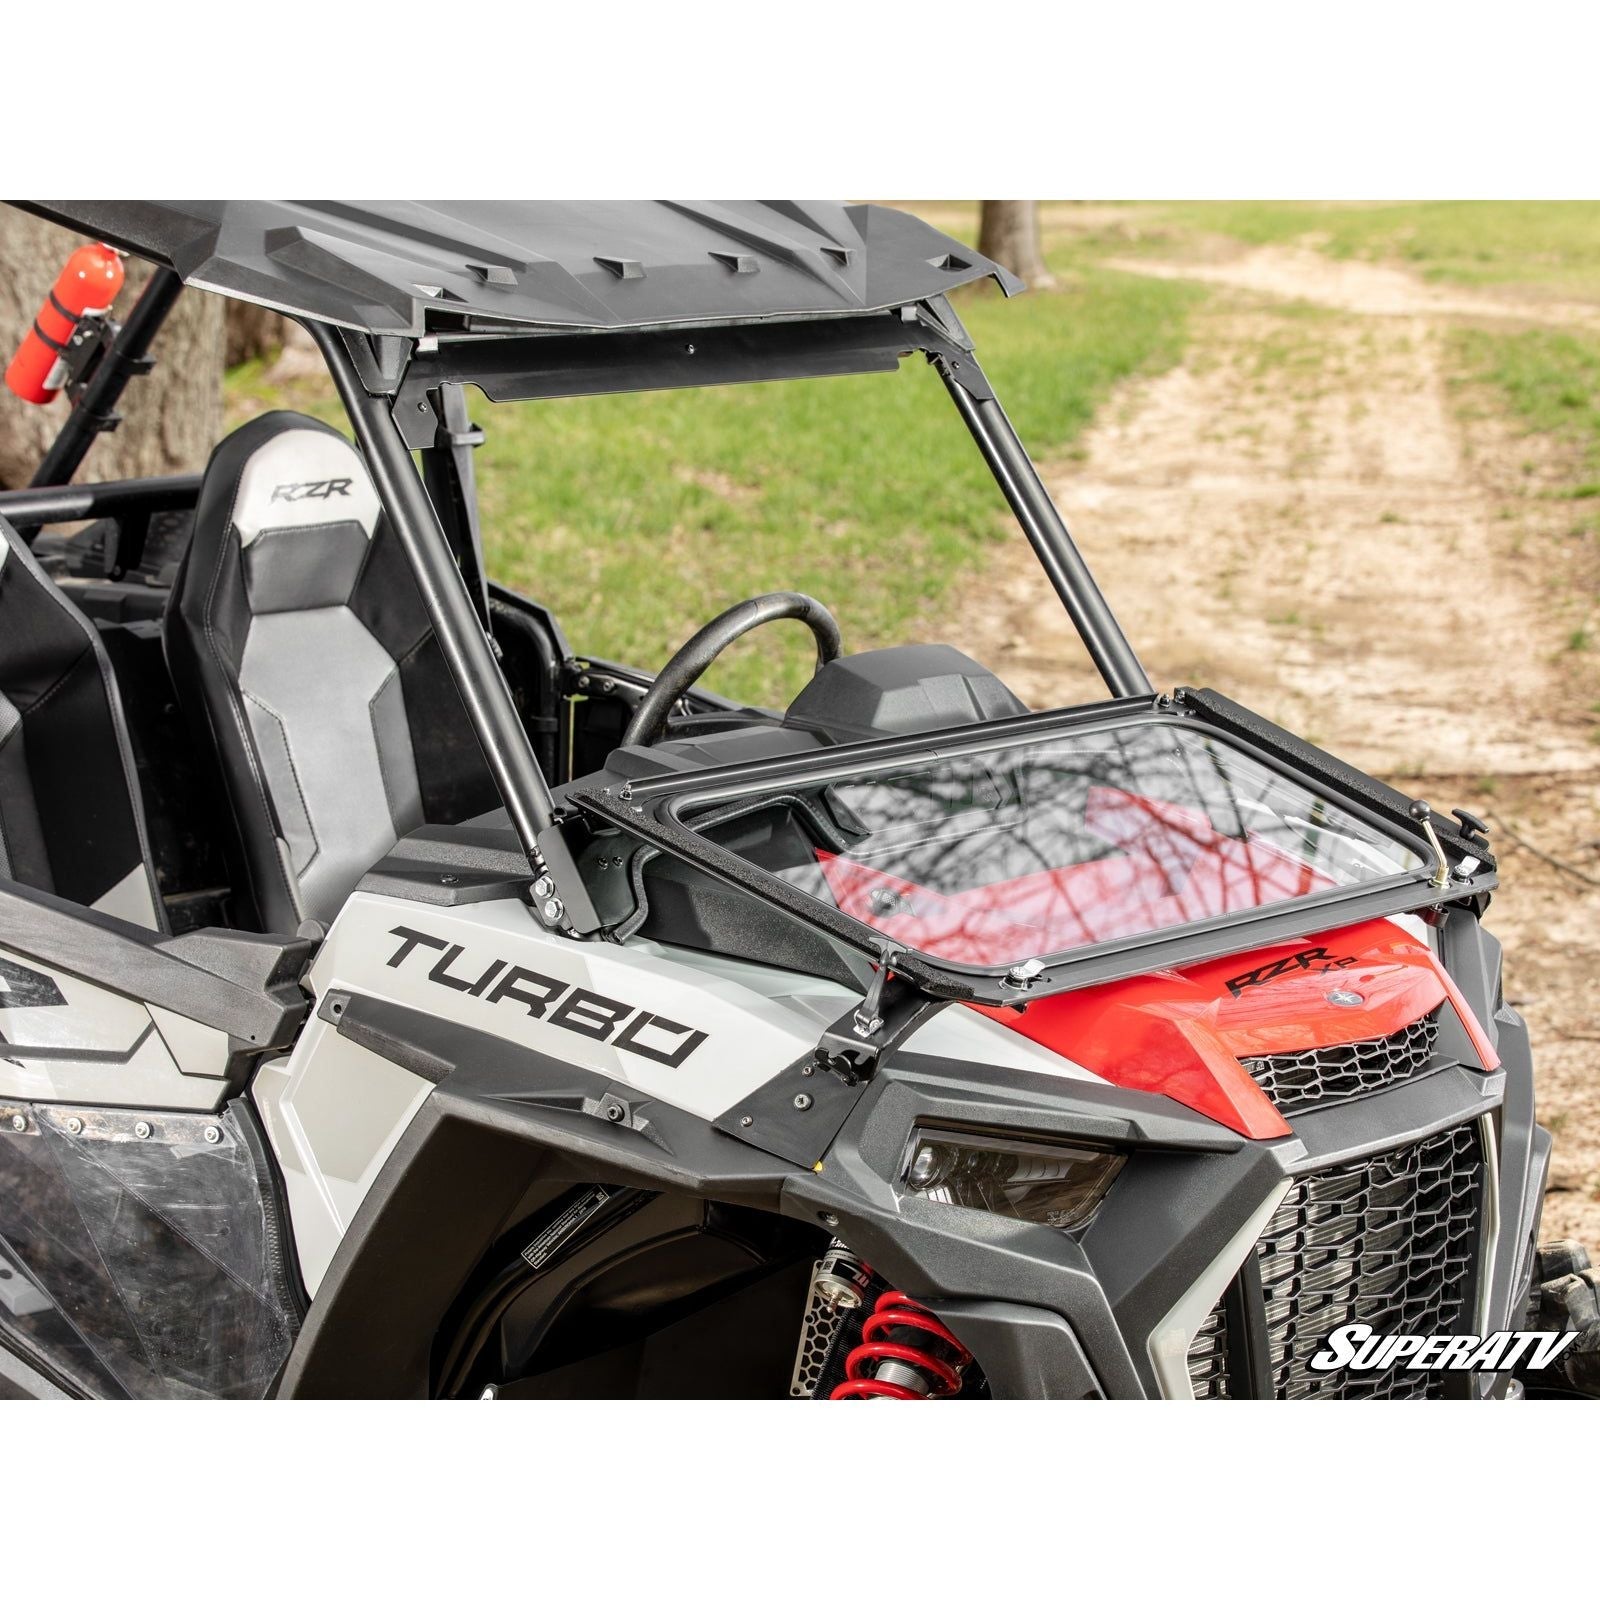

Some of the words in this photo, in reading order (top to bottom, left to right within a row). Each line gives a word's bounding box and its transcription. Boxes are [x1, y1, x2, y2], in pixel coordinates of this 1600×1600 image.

[270, 477, 352, 505] RZR
[386, 925, 709, 1068] TURBO
[1225, 947, 1338, 998] RZR
